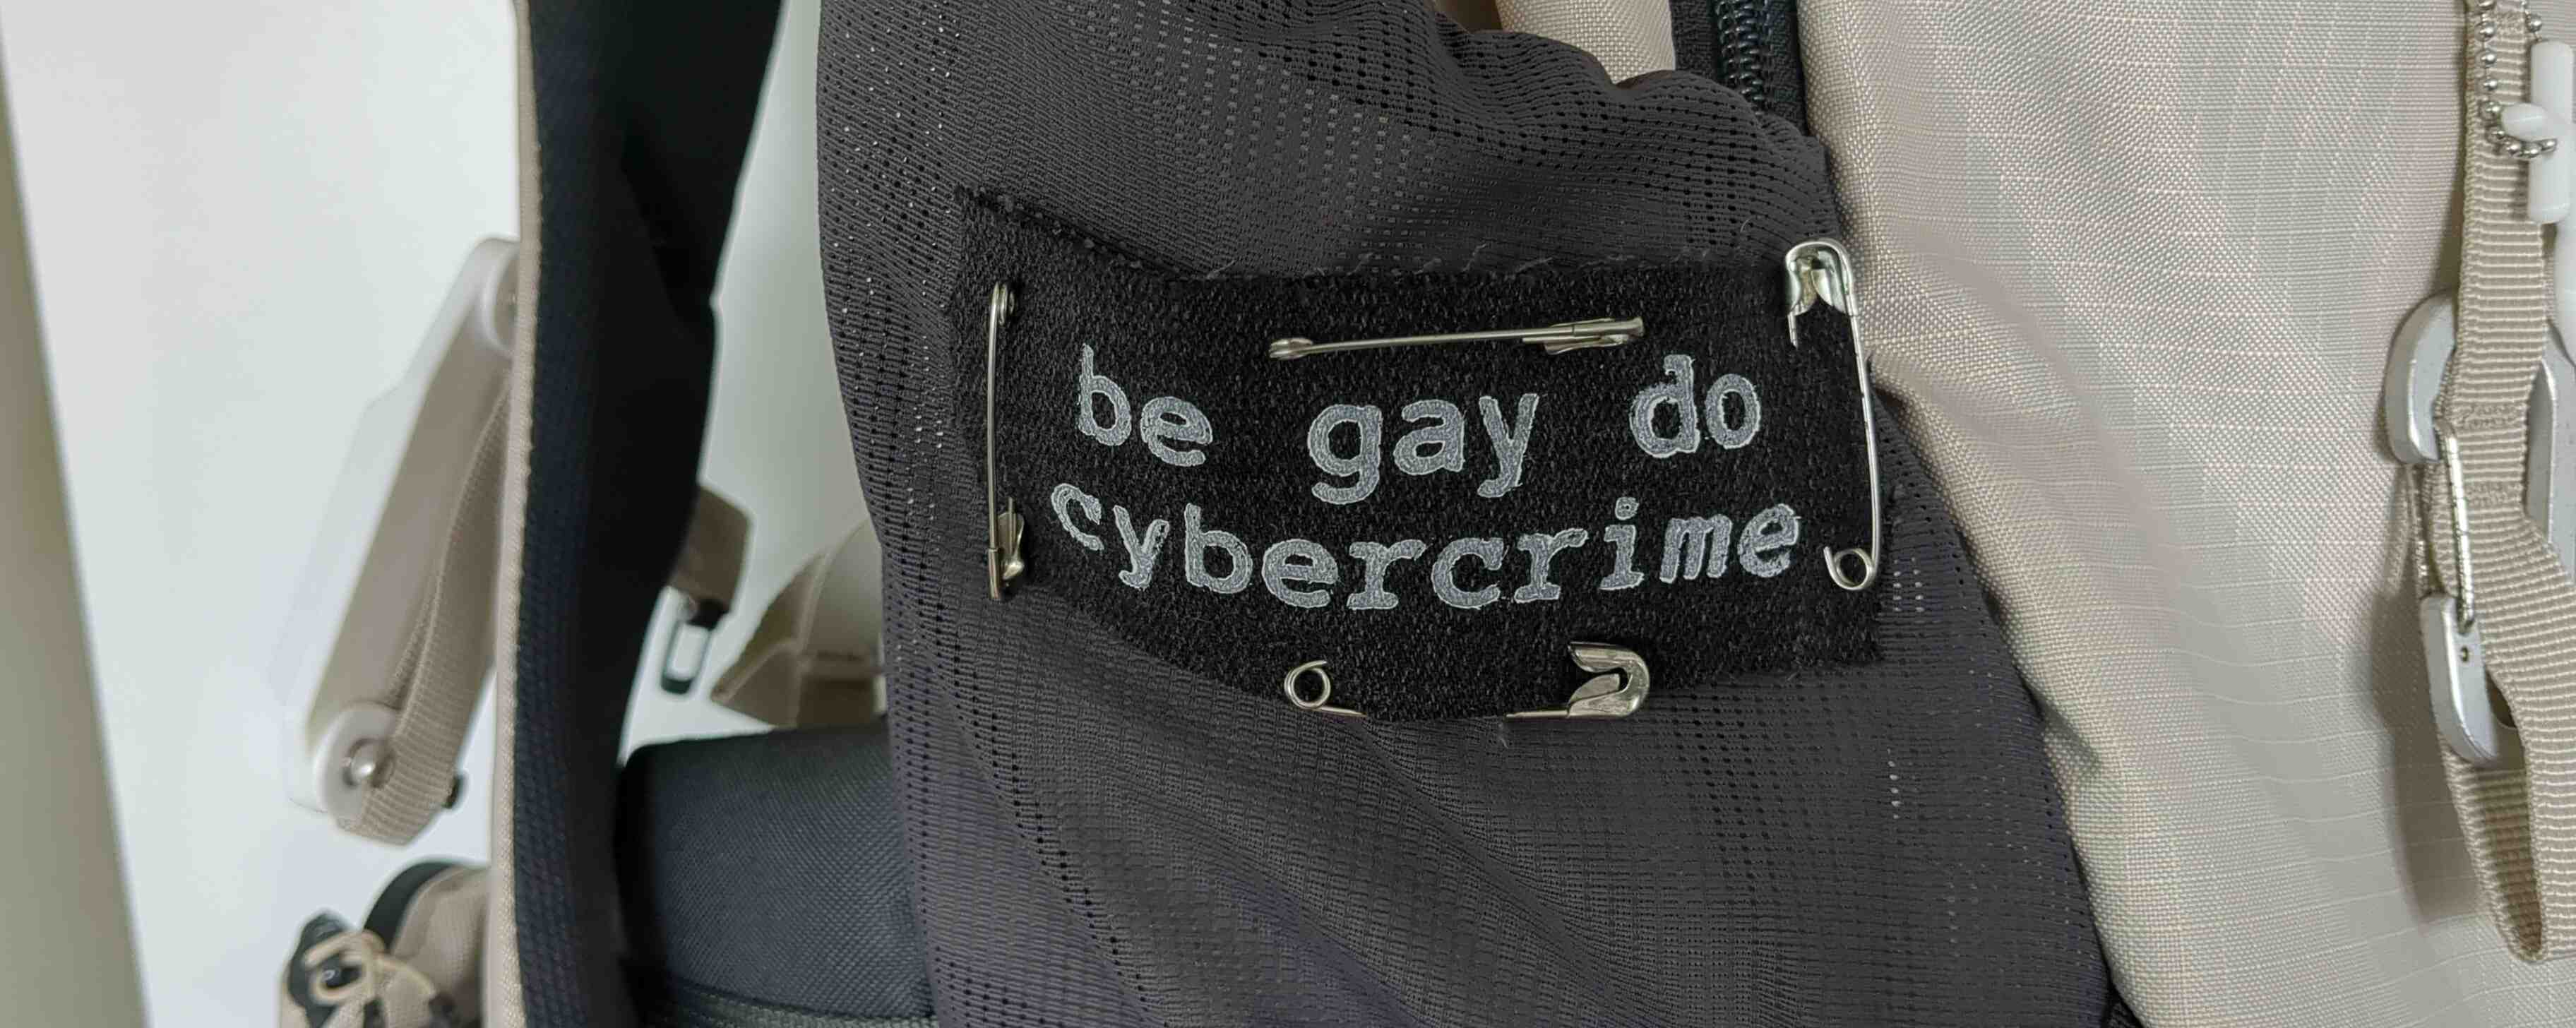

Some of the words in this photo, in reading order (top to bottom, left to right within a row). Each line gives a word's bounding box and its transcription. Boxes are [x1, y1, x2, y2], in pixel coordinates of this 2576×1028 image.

[1077, 342, 1214, 467] be
[1306, 393, 1540, 506] gay
[1629, 354, 1763, 460] do
[1049, 482, 1801, 611] cybercrime
